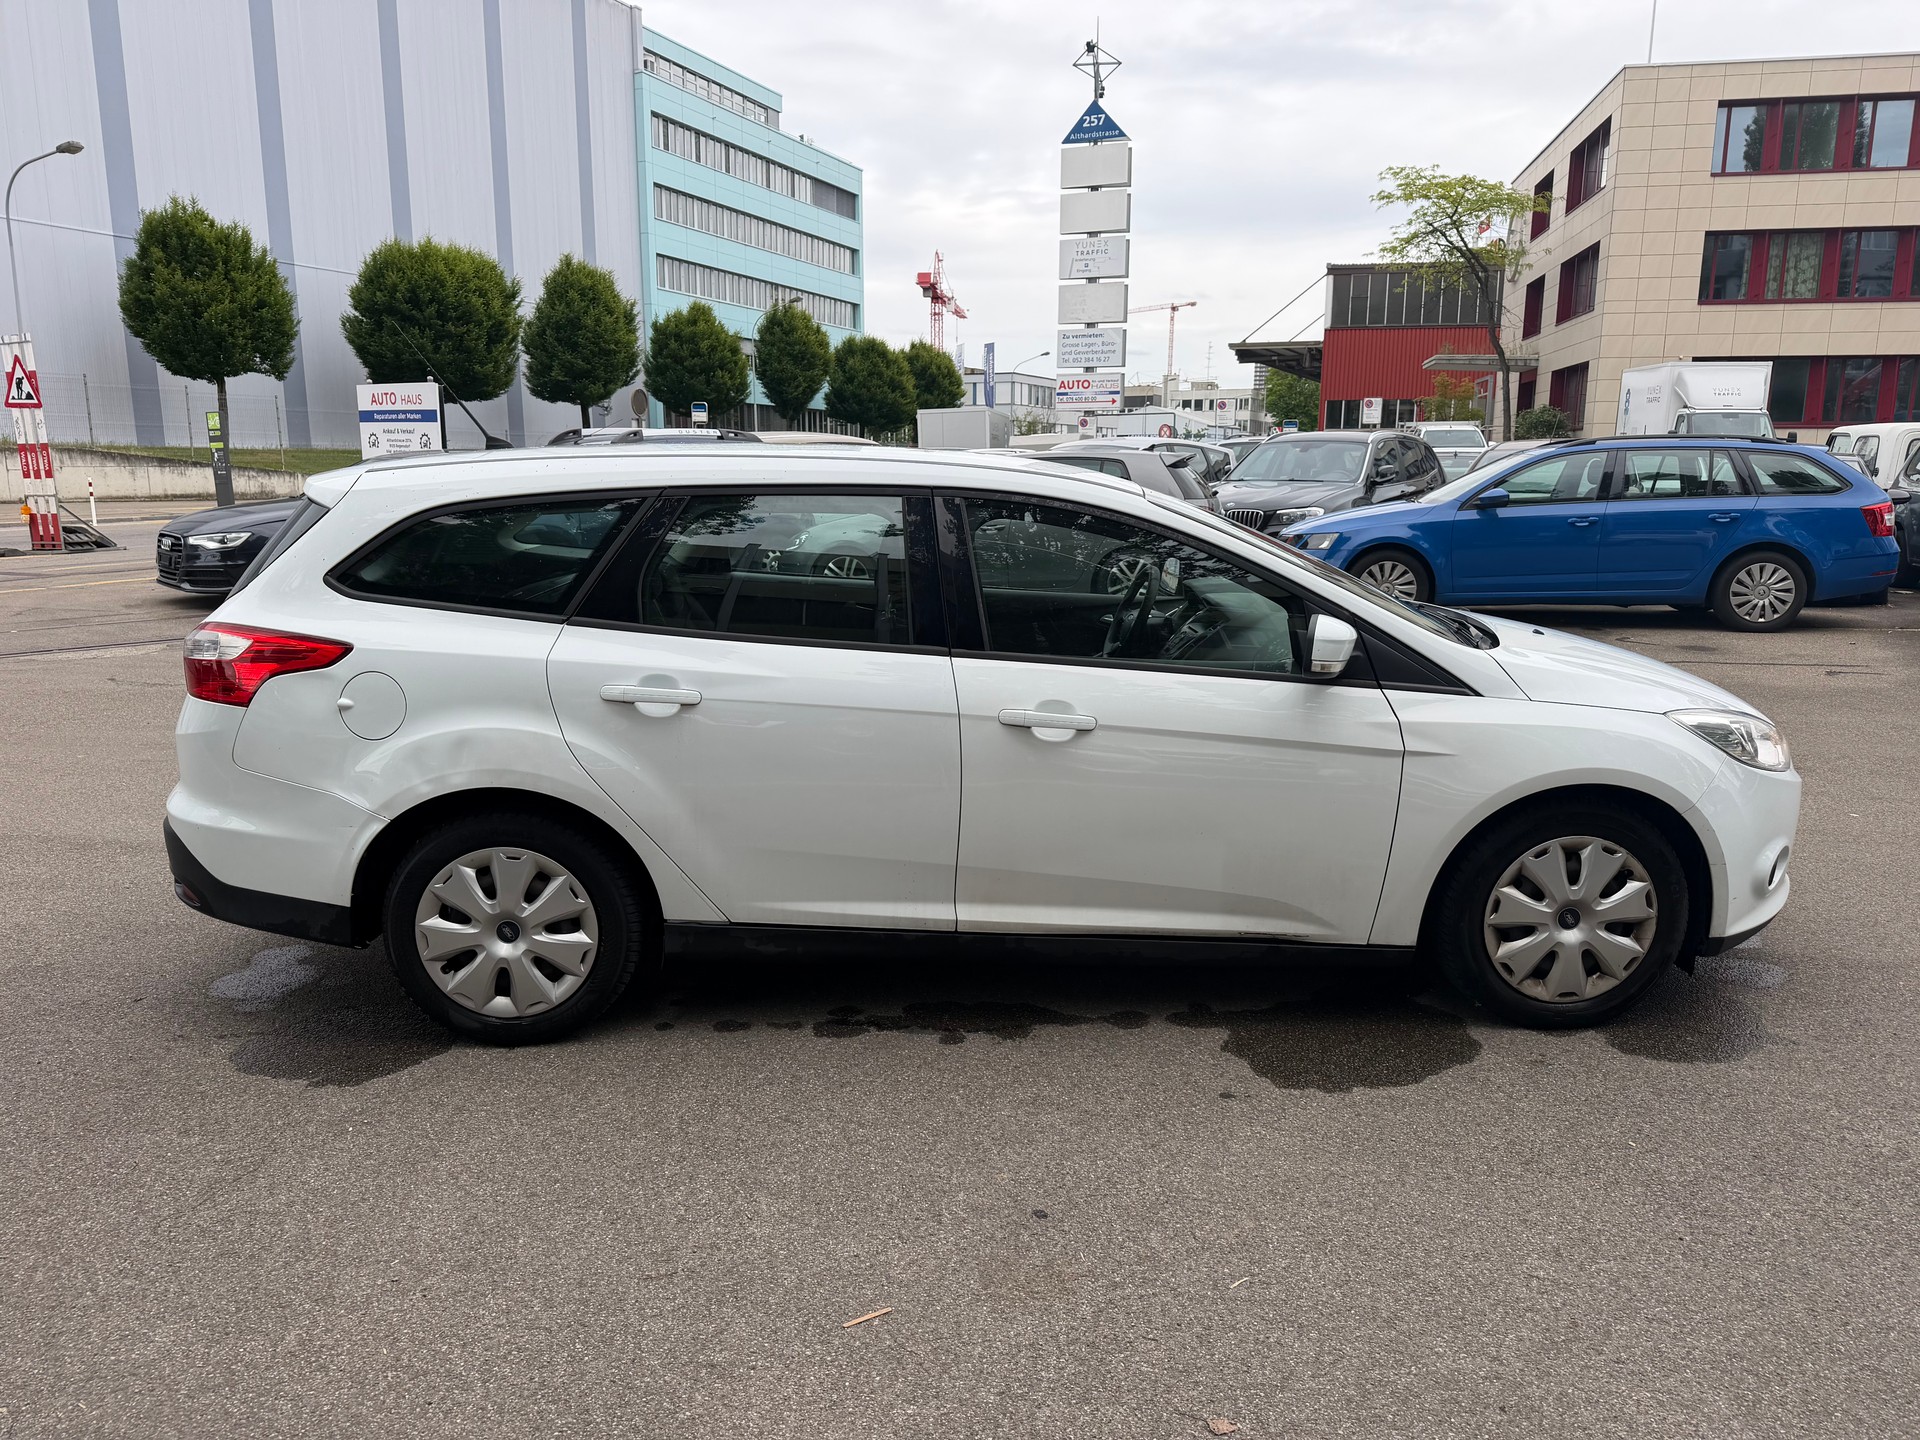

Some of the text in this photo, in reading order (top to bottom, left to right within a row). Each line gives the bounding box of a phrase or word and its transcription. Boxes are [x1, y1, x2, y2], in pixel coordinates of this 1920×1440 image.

[1082, 114, 1105, 127] 257
[1070, 129, 1120, 140] Althardstrasse
[1075, 240, 1109, 249] YUNEX
[1058, 379, 1091, 390] AUTO
[371, 392, 423, 406] AUTO HAUS
[20, 451, 28, 471] WALO
